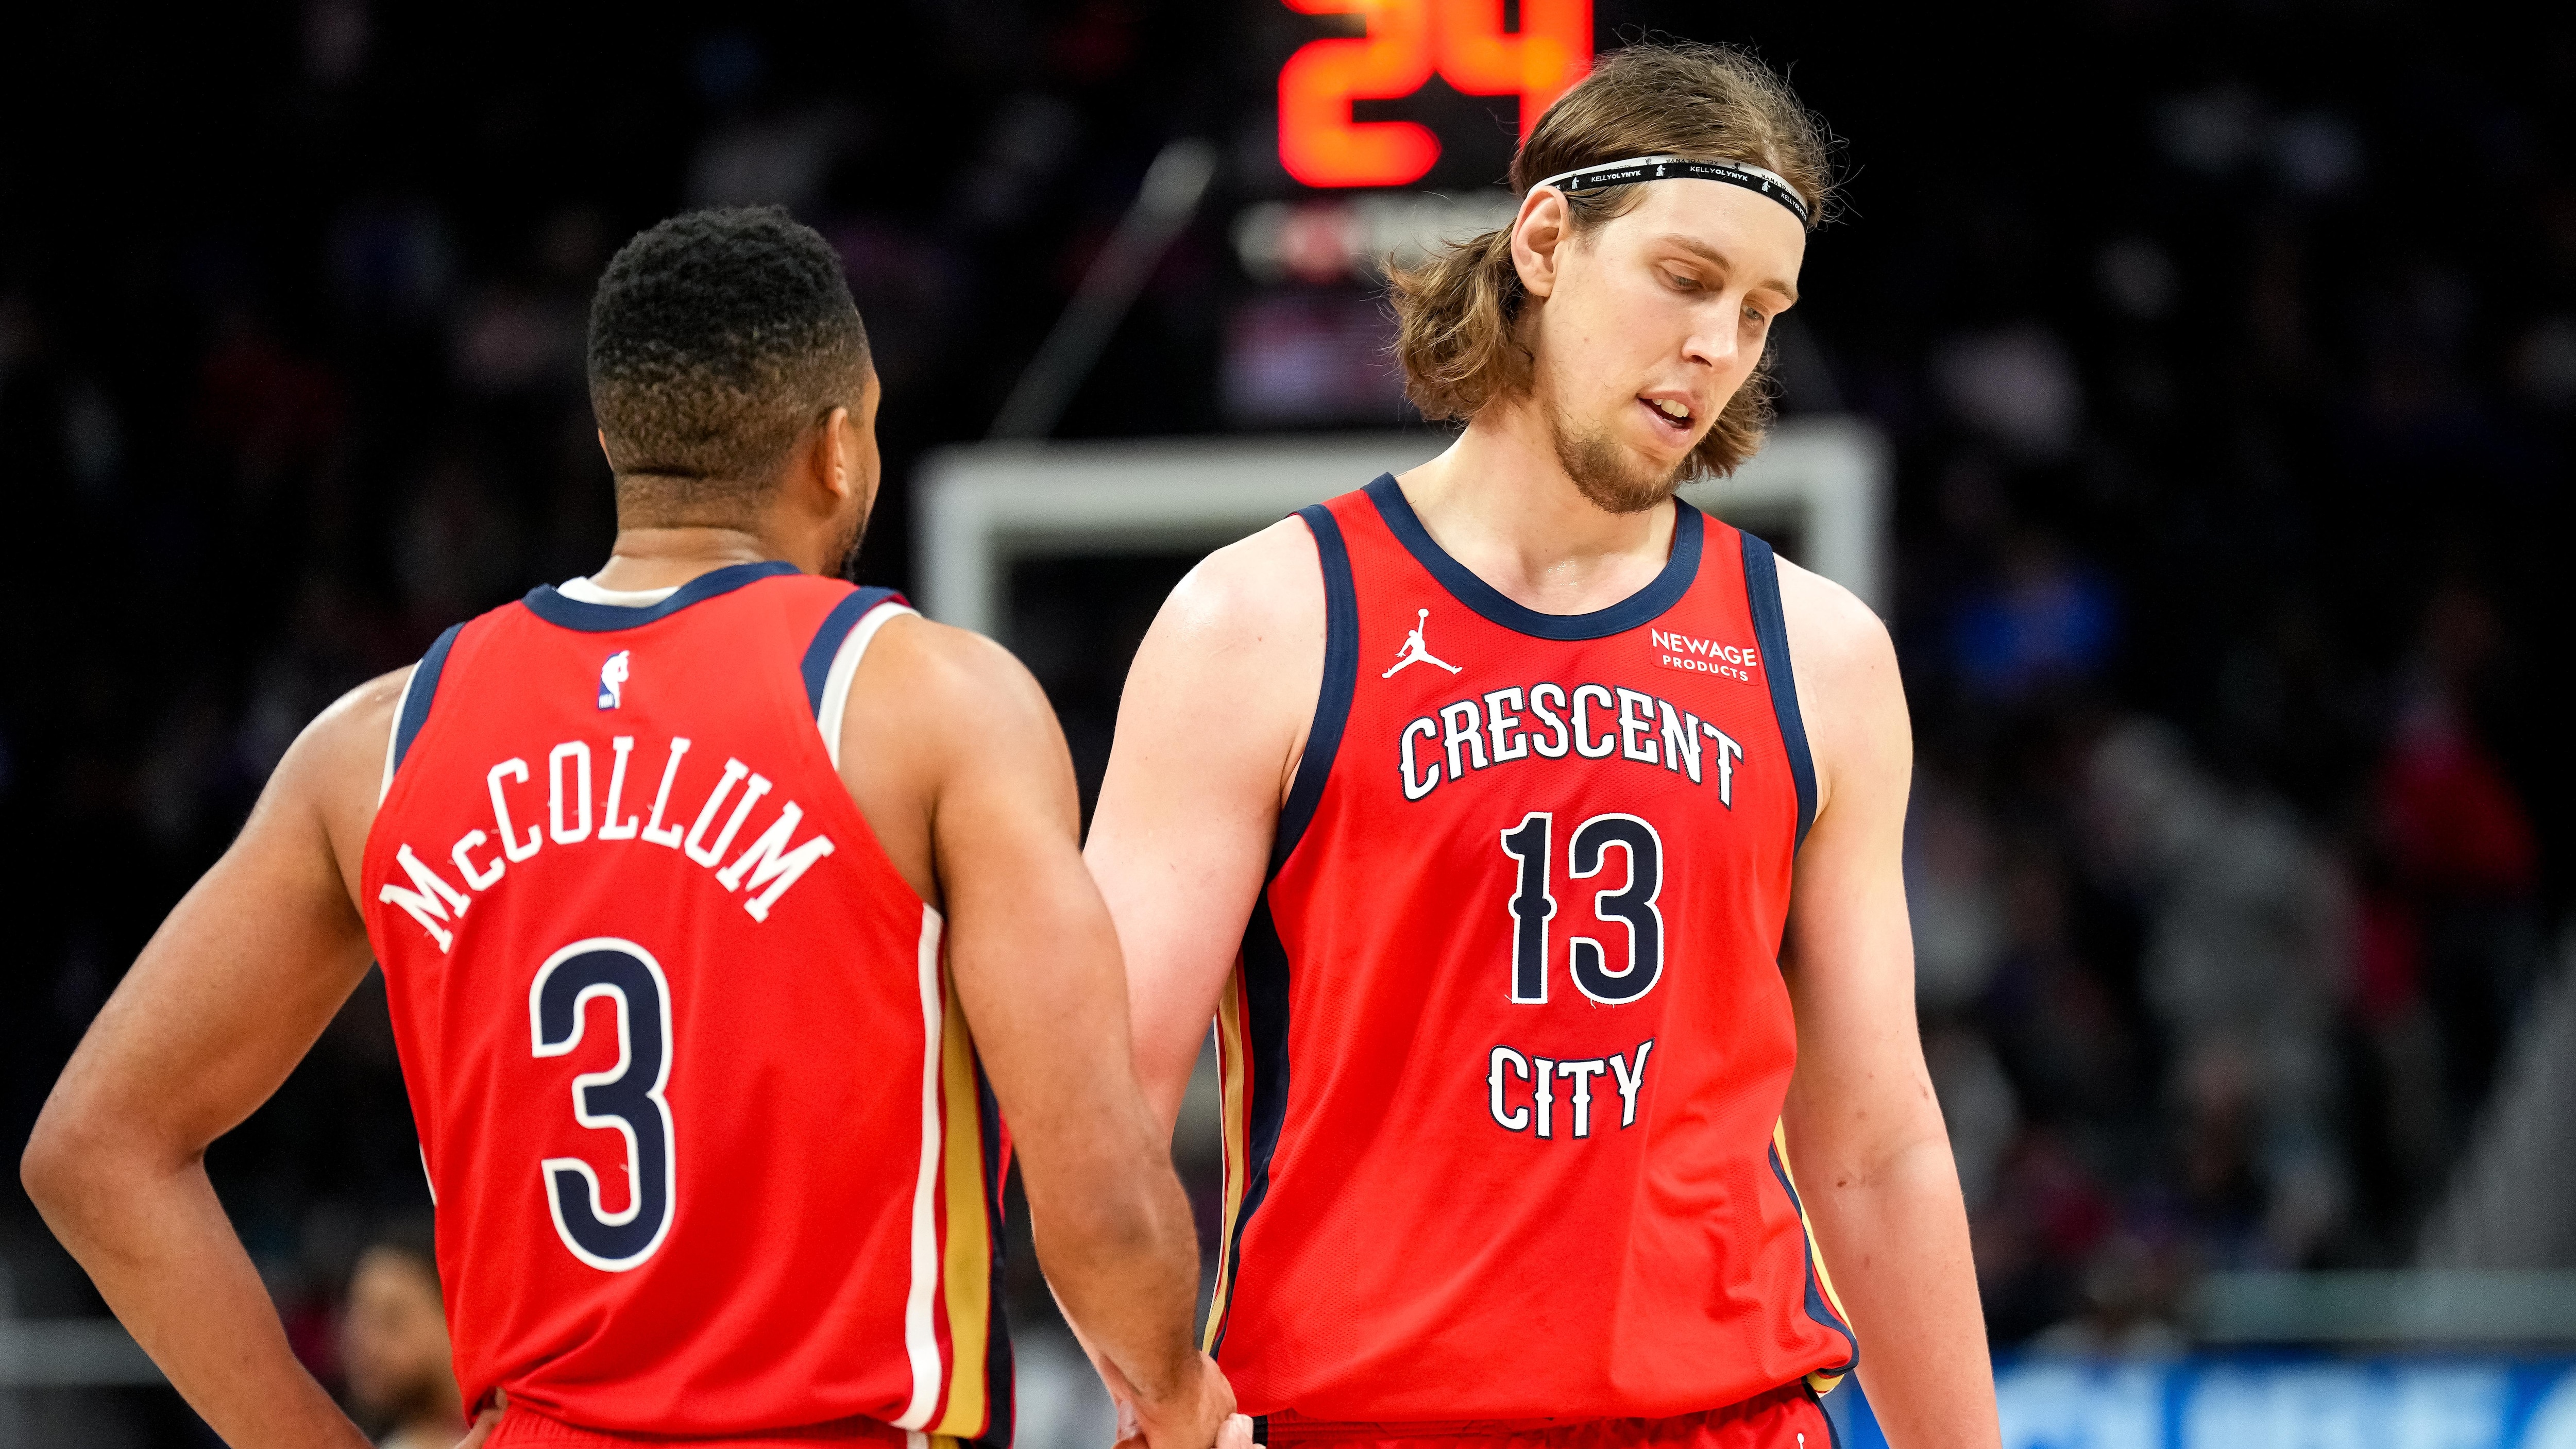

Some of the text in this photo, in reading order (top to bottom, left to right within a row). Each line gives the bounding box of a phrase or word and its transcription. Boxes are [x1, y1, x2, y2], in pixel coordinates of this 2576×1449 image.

[1278, 0, 1594, 189] 24
[1591, 170, 1641, 182] KELLYOLYNYK
[1690, 166, 1748, 181] KELLYOLYNYK
[1651, 628, 1757, 666] NEWAGE
[1662, 655, 1749, 681] PRODUCTS
[1398, 682, 1744, 811] CRESCENT
[379, 736, 836, 954] McCOLLUM
[1500, 812, 1664, 1005] 13
[529, 936, 675, 1272] 3
[1485, 1037, 1655, 1140] CITY
